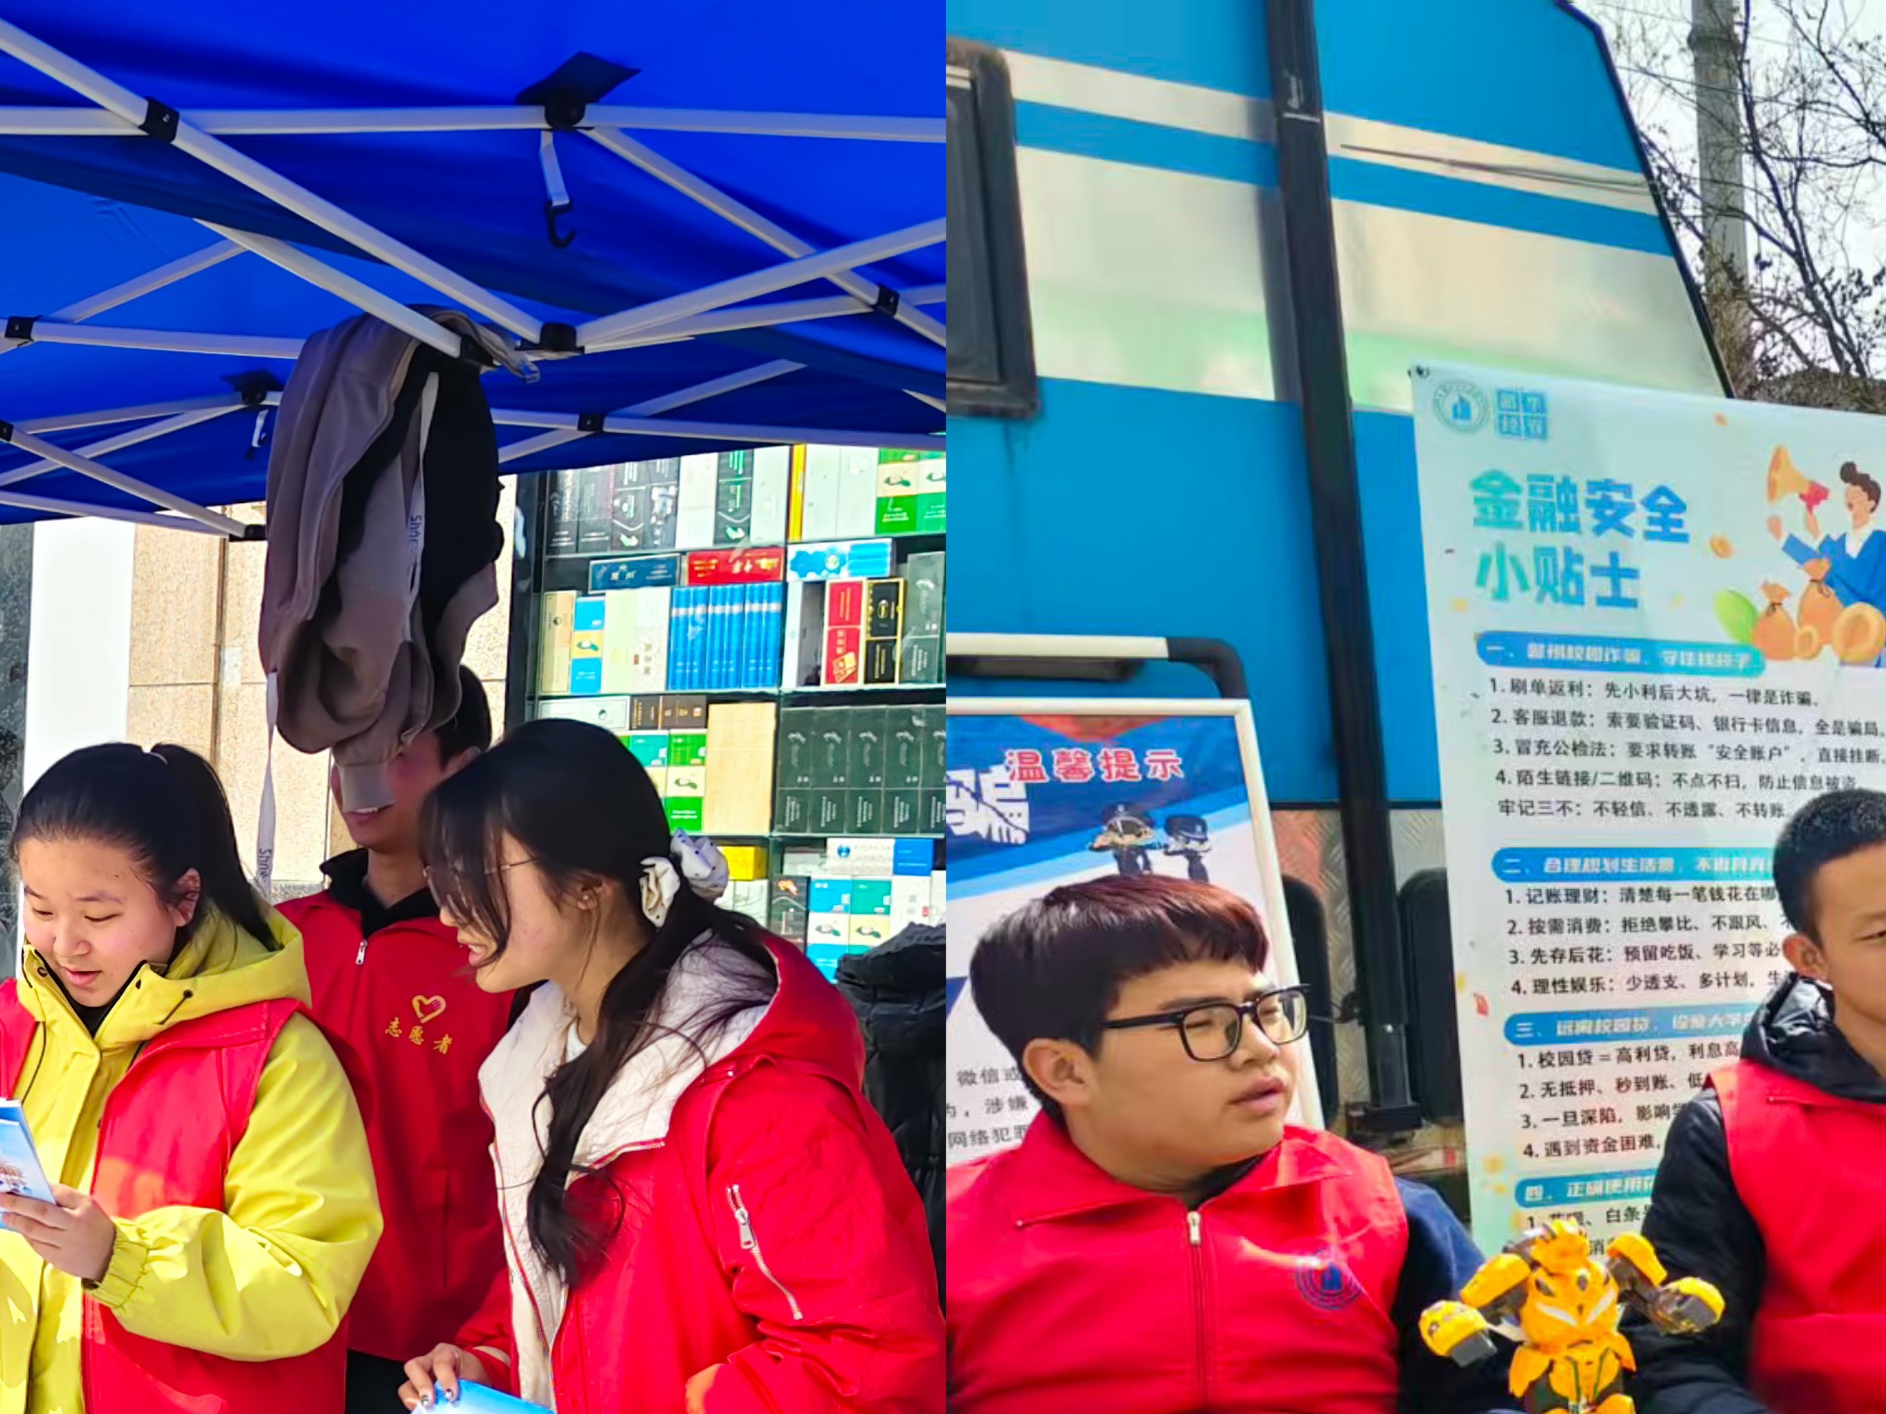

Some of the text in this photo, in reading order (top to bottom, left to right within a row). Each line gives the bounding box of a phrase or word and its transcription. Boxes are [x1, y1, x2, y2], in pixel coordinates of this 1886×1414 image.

[1469, 469, 1690, 544] 金融安全
[1475, 541, 1641, 609] 小贴士
[1004, 747, 1184, 785] 温馨提示
[385, 1015, 452, 1056] 志愿者
